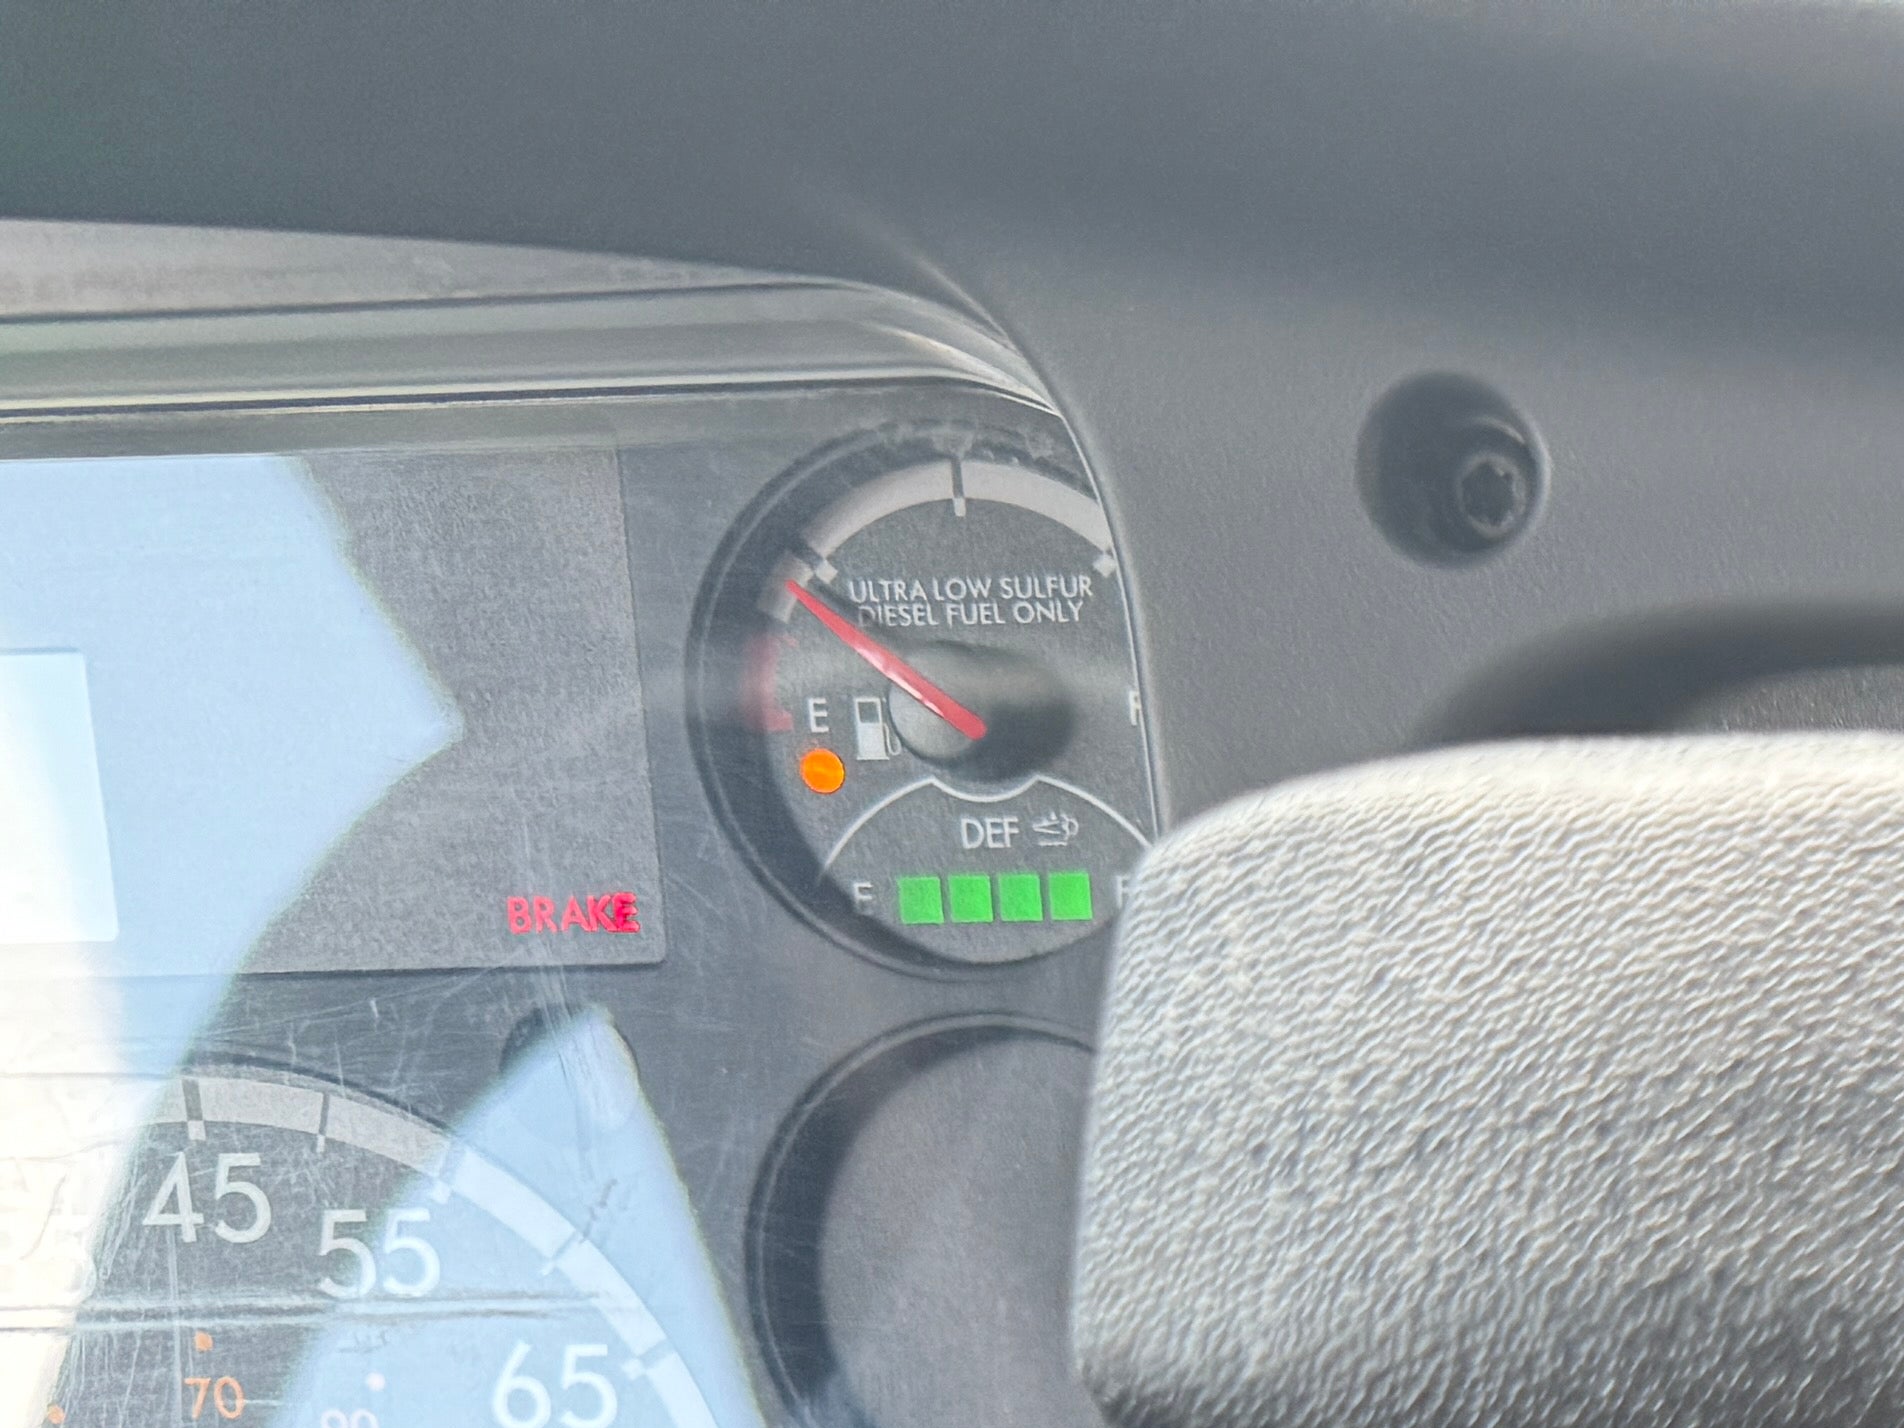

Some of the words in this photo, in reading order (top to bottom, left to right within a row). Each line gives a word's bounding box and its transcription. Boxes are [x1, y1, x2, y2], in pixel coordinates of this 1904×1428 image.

[849, 577, 927, 603] ULTRA
[933, 577, 993, 600] LOW
[1000, 574, 1094, 600] SULFUR
[858, 603, 938, 627] DIESEL
[946, 601, 1005, 626] FUEL
[1013, 600, 1084, 624] ONLY
[810, 698, 829, 733] E
[960, 816, 1020, 849] DEF
[507, 892, 640, 934] BRAKE
[142, 1152, 272, 1244] 45
[319, 1208, 441, 1299] 55
[185, 1377, 245, 1420] 70
